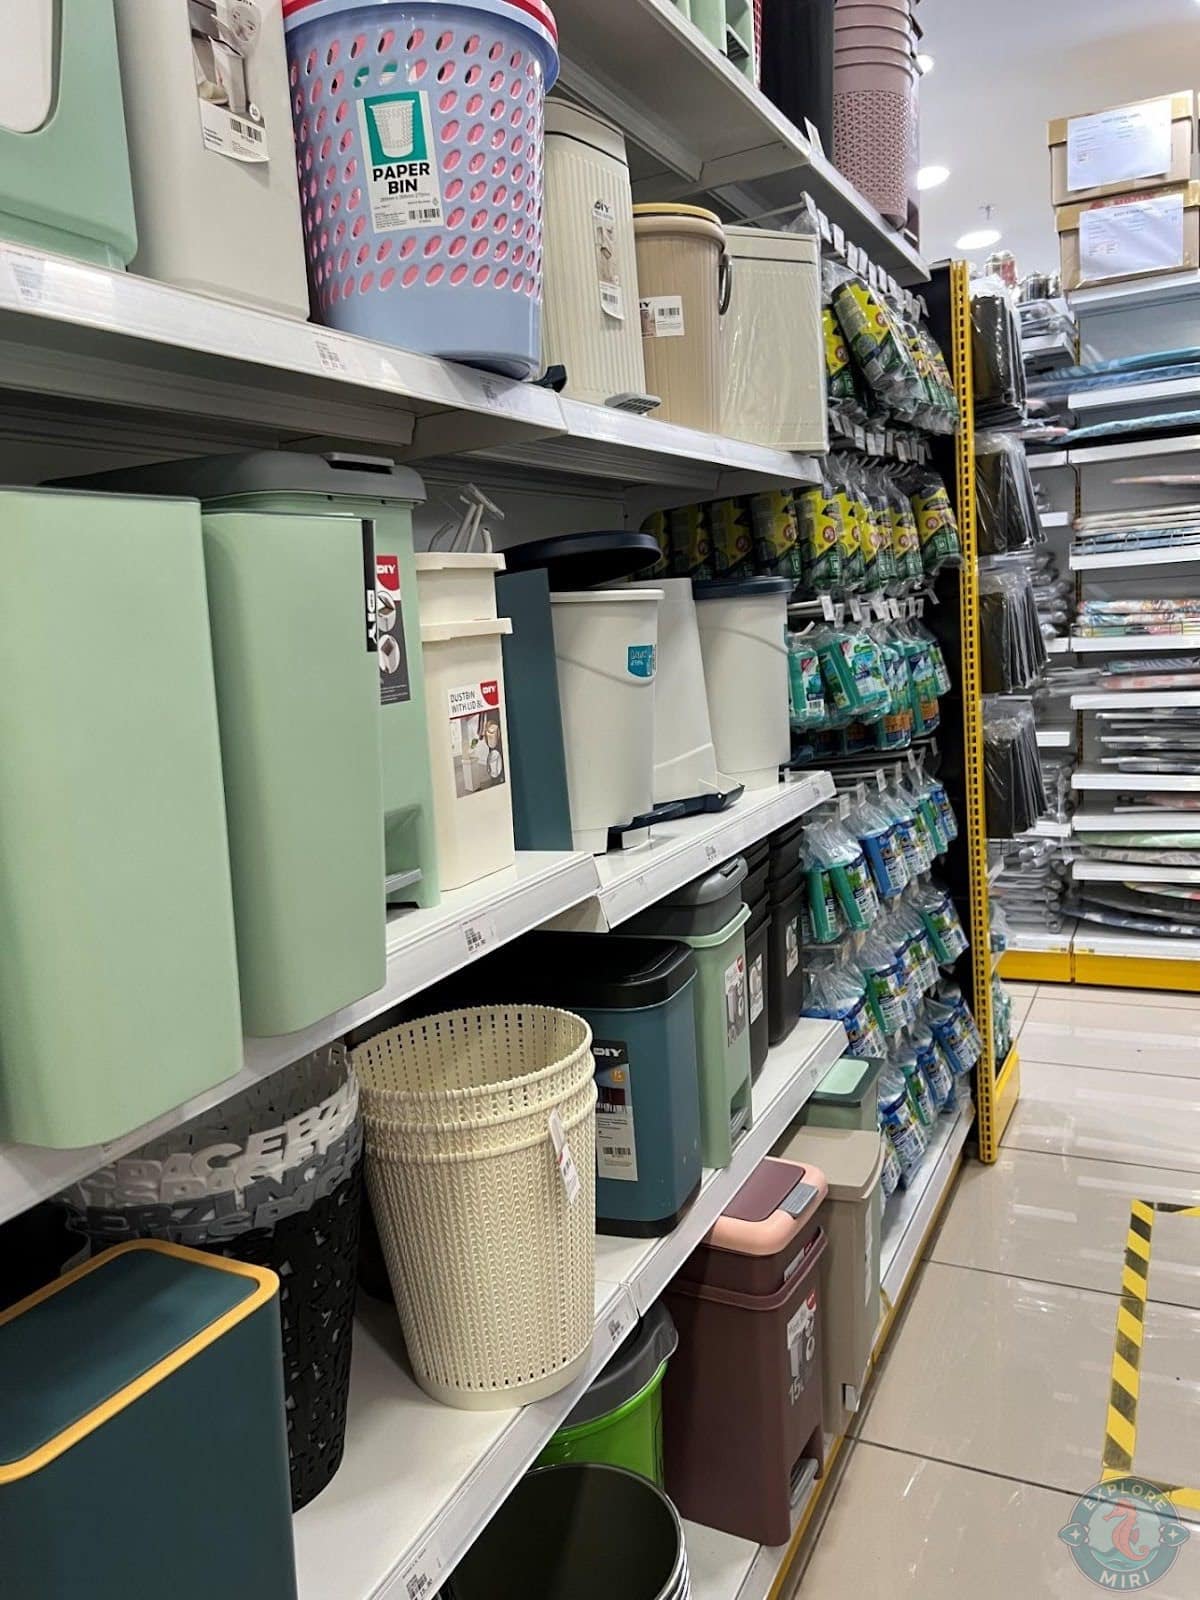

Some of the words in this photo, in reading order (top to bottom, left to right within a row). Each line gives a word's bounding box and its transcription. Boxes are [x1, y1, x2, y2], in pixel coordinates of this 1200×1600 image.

[372, 162, 431, 182] PAPER
[388, 178, 418, 195] BIN
[594, 200, 610, 213] DIY
[376, 564, 396, 575] DIY
[450, 690, 476, 703] DUSTBIN
[451, 702, 467, 713] WITH
[592, 1047, 622, 1057] DIY
